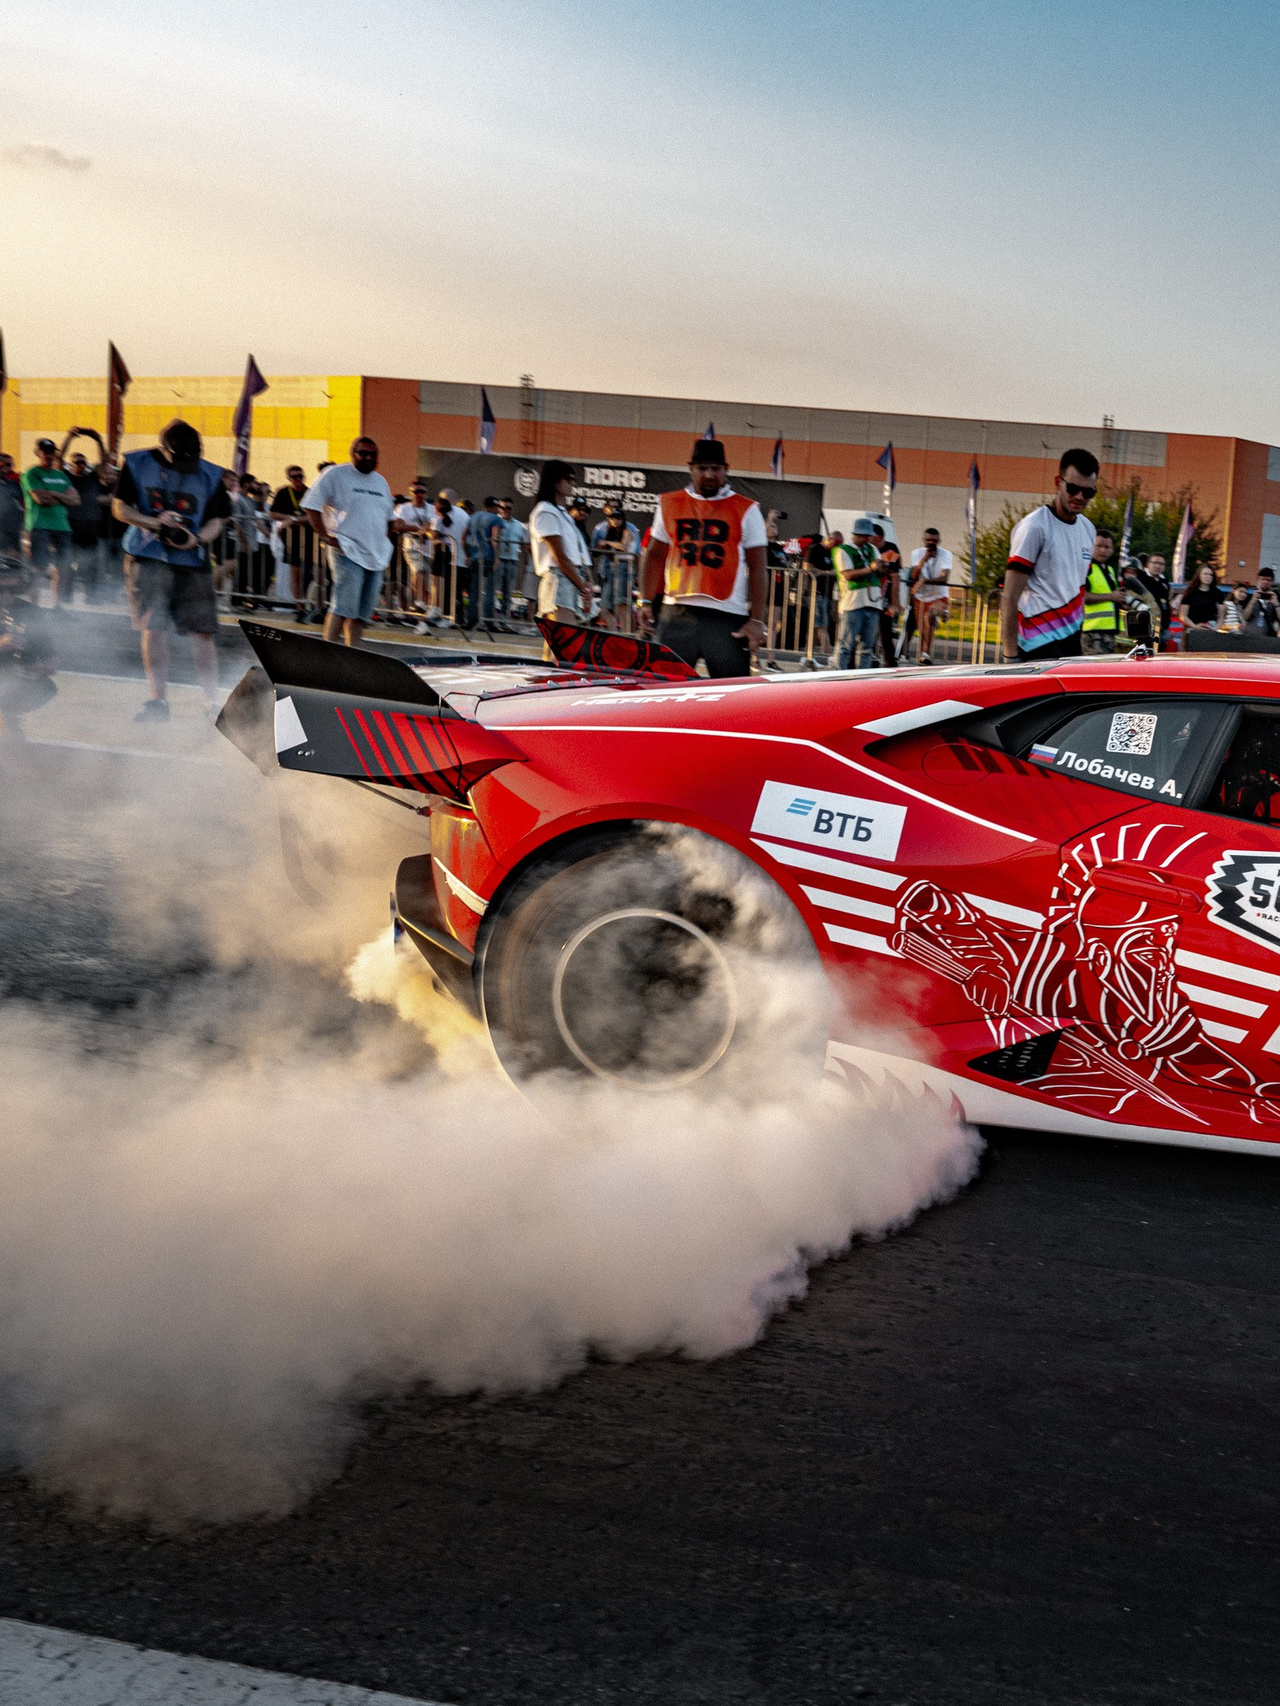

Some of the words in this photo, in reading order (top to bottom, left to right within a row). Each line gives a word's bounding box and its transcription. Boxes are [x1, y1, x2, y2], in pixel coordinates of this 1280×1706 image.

[583, 466, 646, 489] RDRC
[1056, 750, 1156, 790] Лобачев
[813, 808, 874, 842] ВТБ
